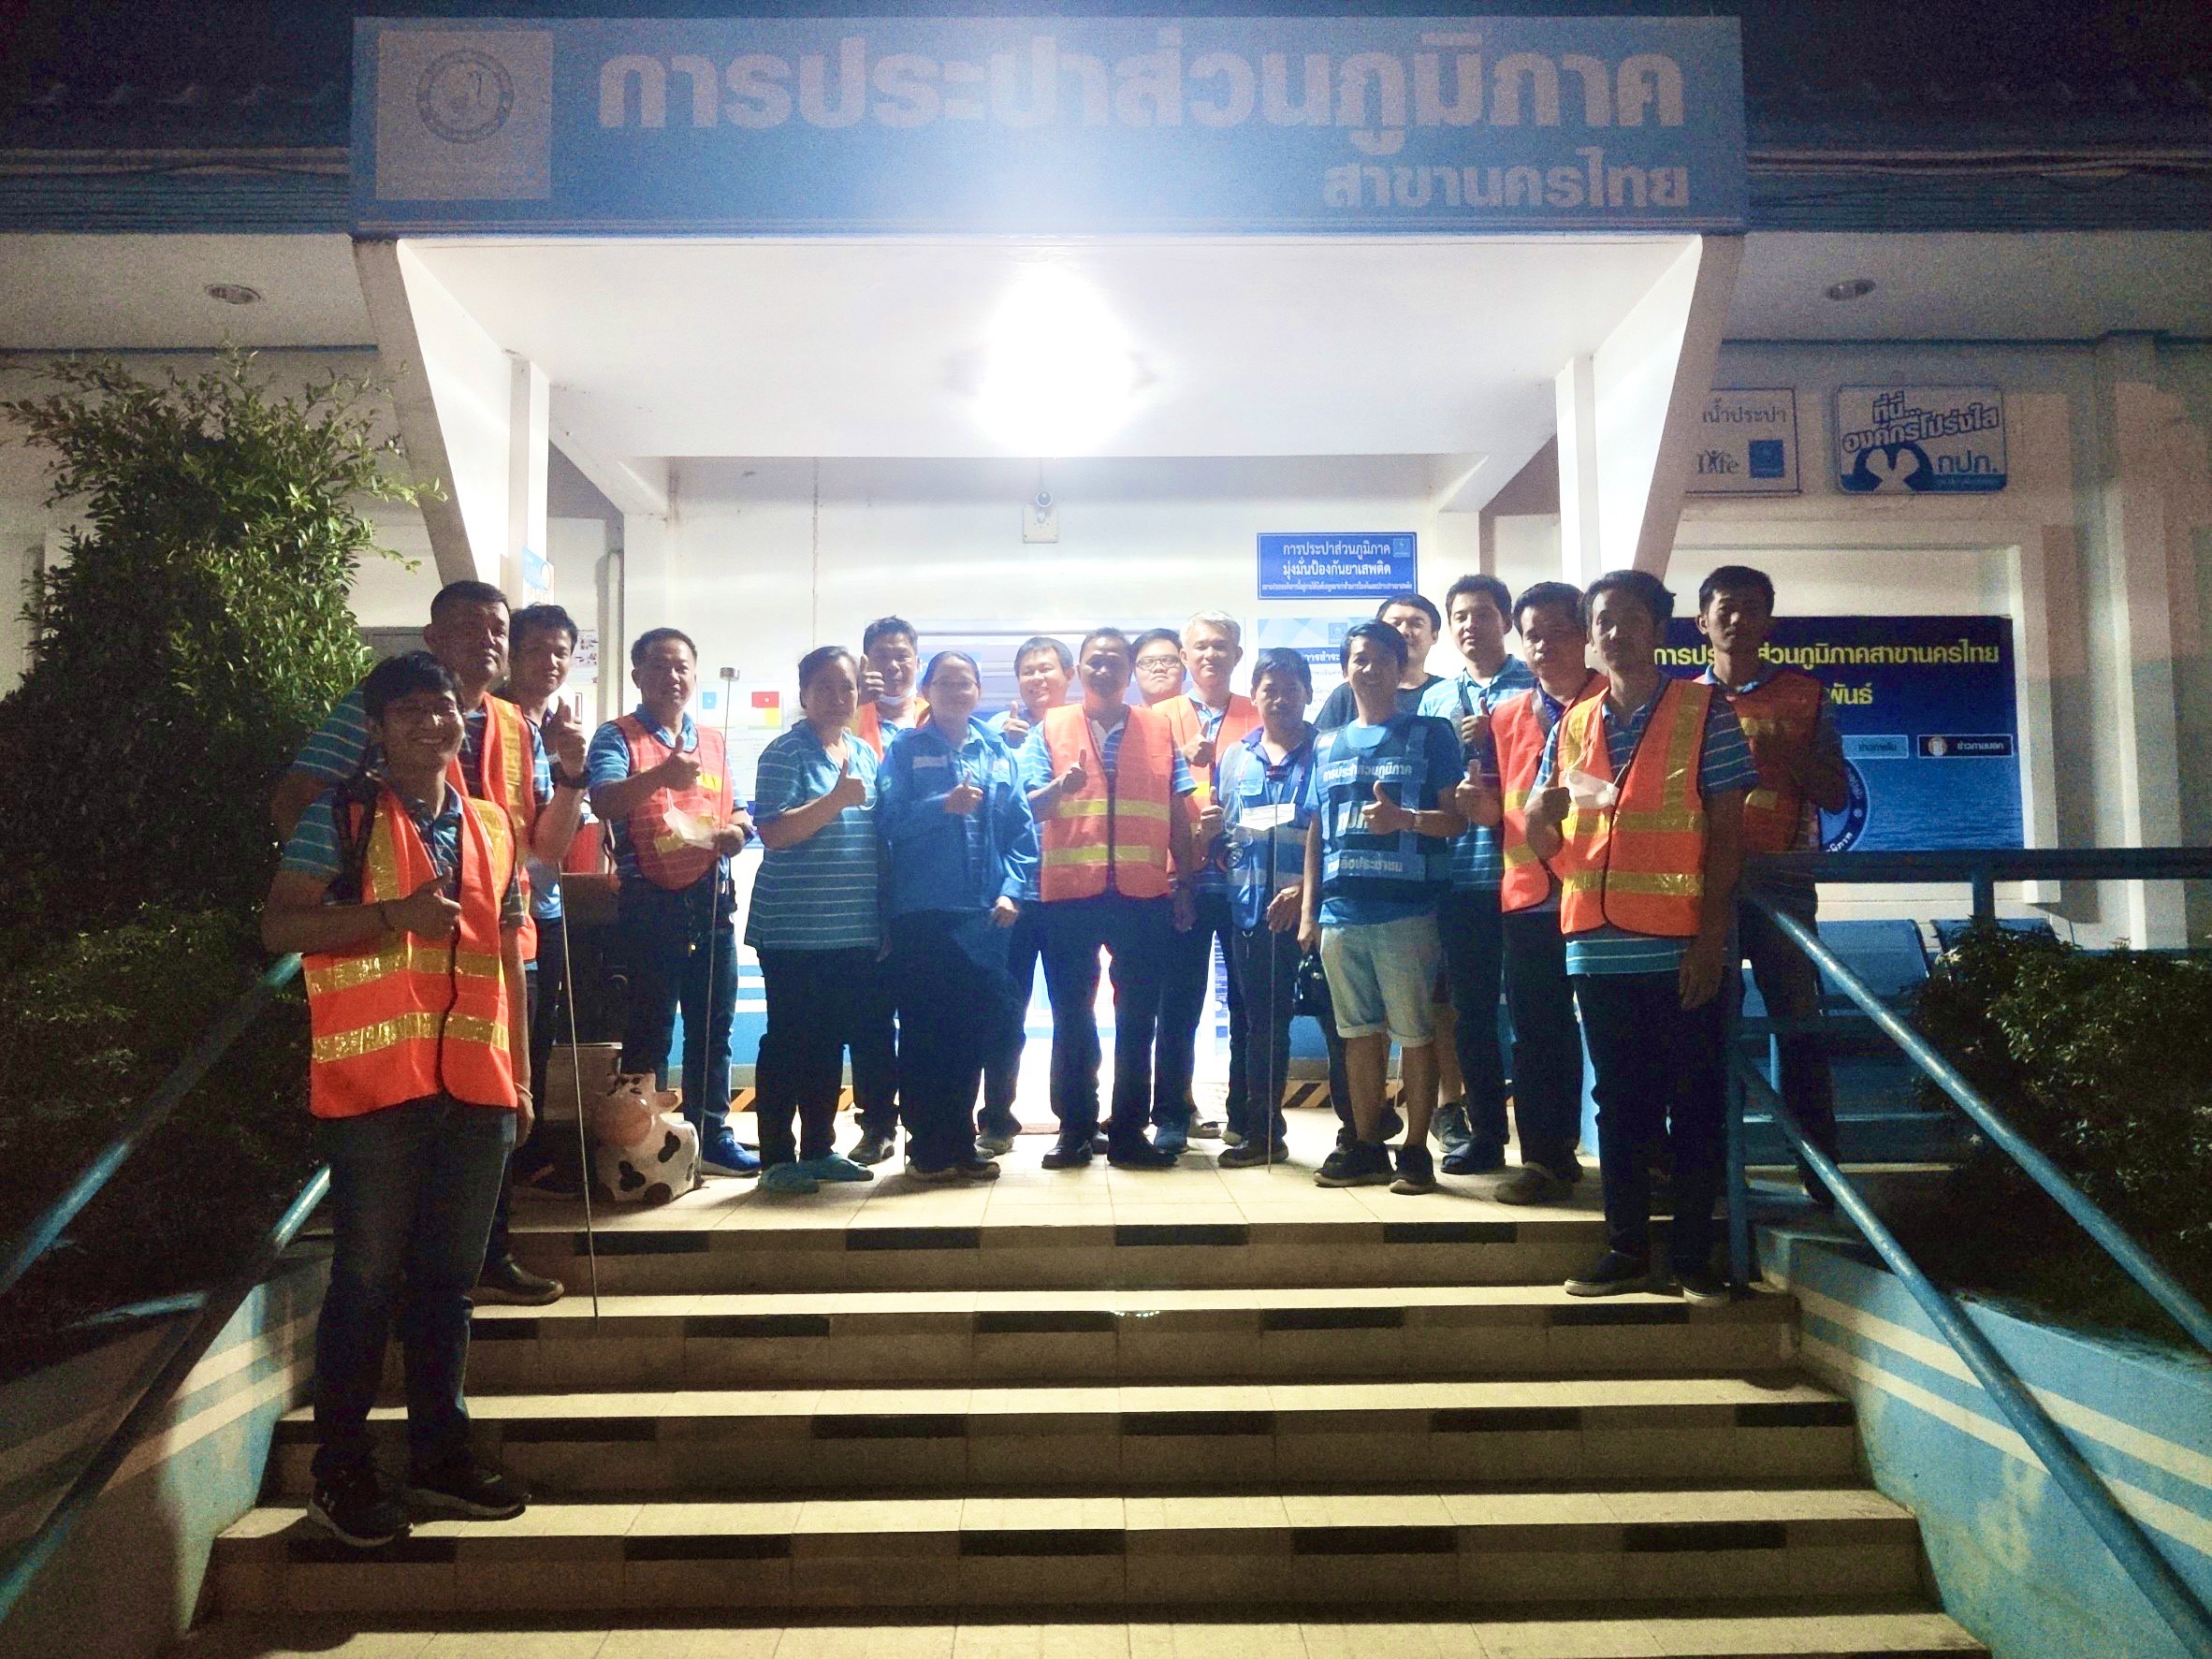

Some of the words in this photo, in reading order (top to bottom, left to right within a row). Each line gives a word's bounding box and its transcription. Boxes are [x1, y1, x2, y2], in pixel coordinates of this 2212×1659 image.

[597, 25, 1685, 156] การประปาส่วนภูมิภาค
[1322, 146, 1691, 209] สาขานครไทย
[1282, 557, 1392, 581] มุ่งมั่นป้องกันยาเสพติด
[1283, 540, 1391, 560] การประปาส่วนภูมิภาค
